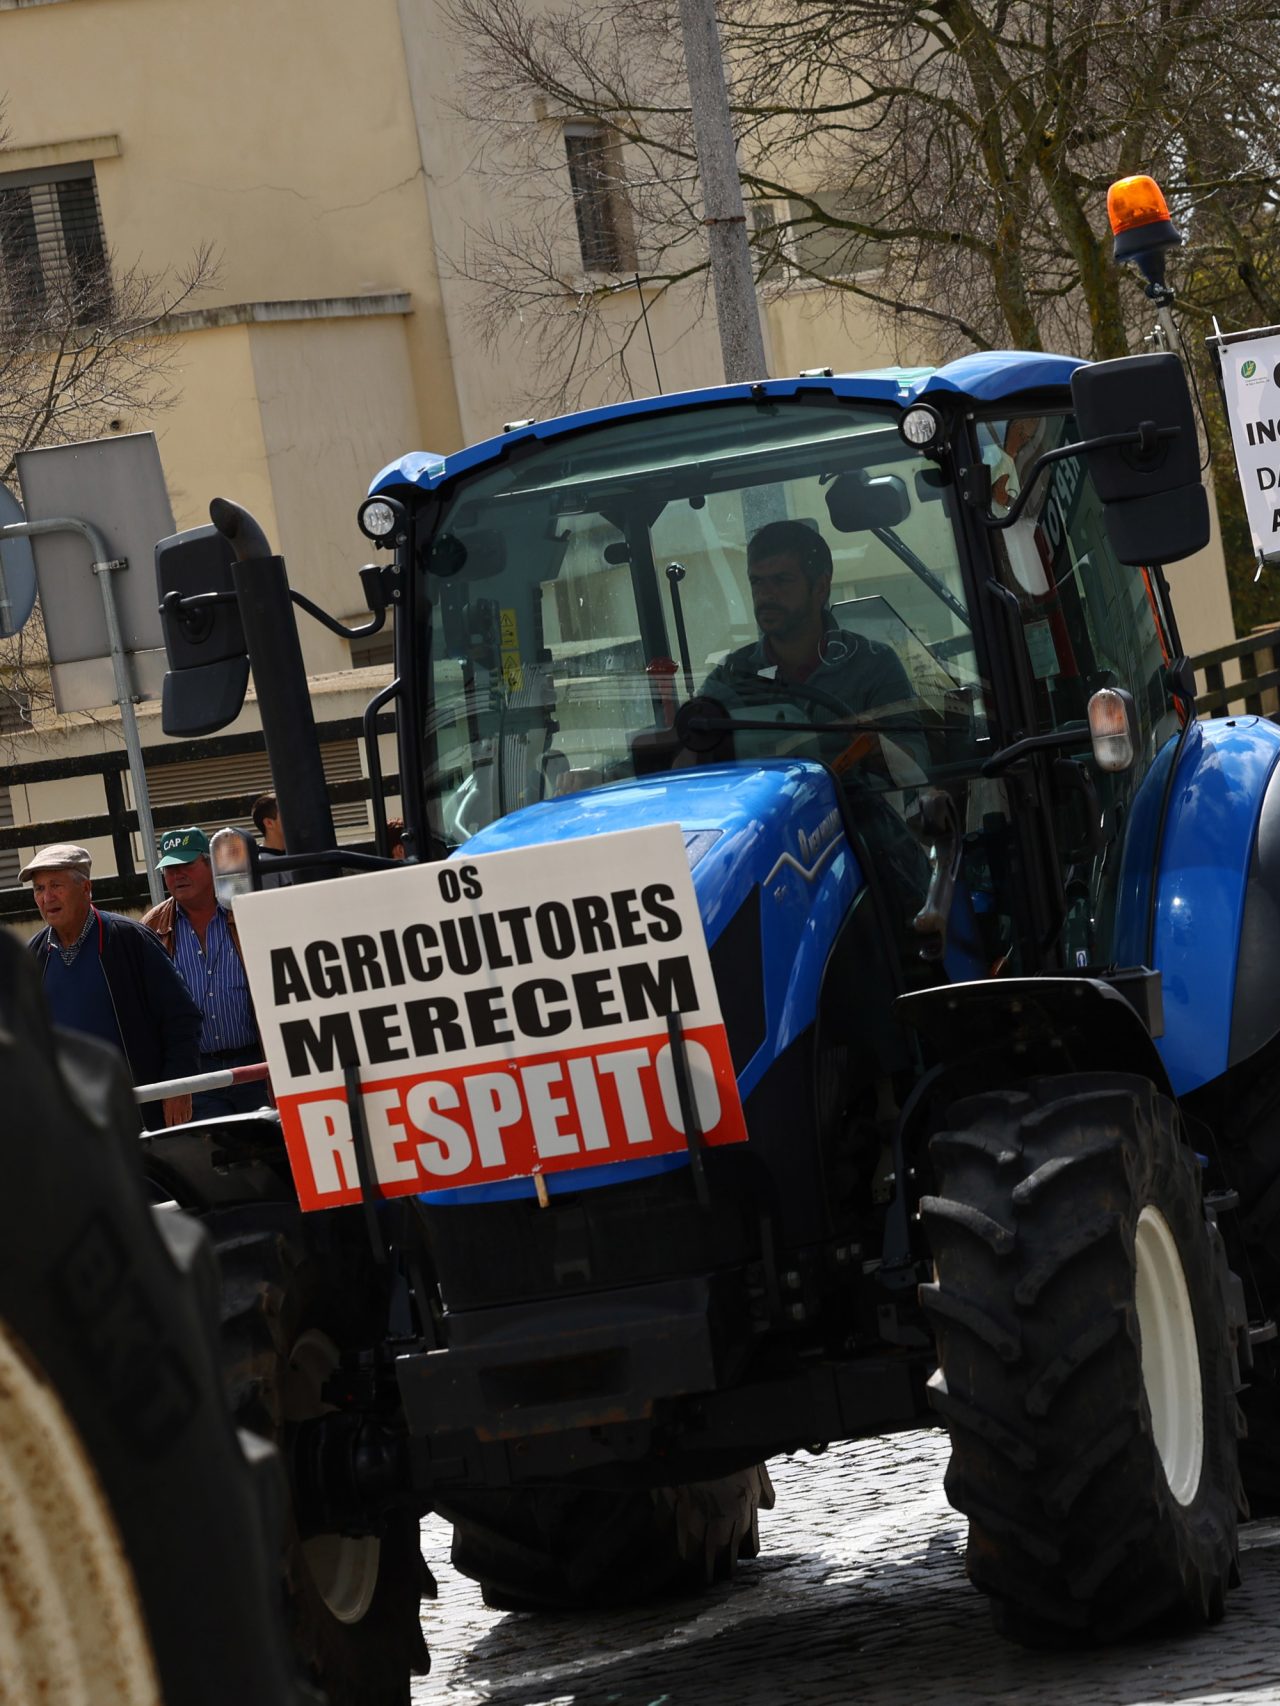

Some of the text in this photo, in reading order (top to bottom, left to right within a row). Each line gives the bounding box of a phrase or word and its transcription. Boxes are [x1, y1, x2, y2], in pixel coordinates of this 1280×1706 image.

[163, 837, 181, 851] CAP
[437, 865, 483, 904] OS
[270, 883, 683, 1006] AGRICULTORES
[279, 955, 700, 1079] MERECEM
[298, 1039, 722, 1195] RESPEITO
